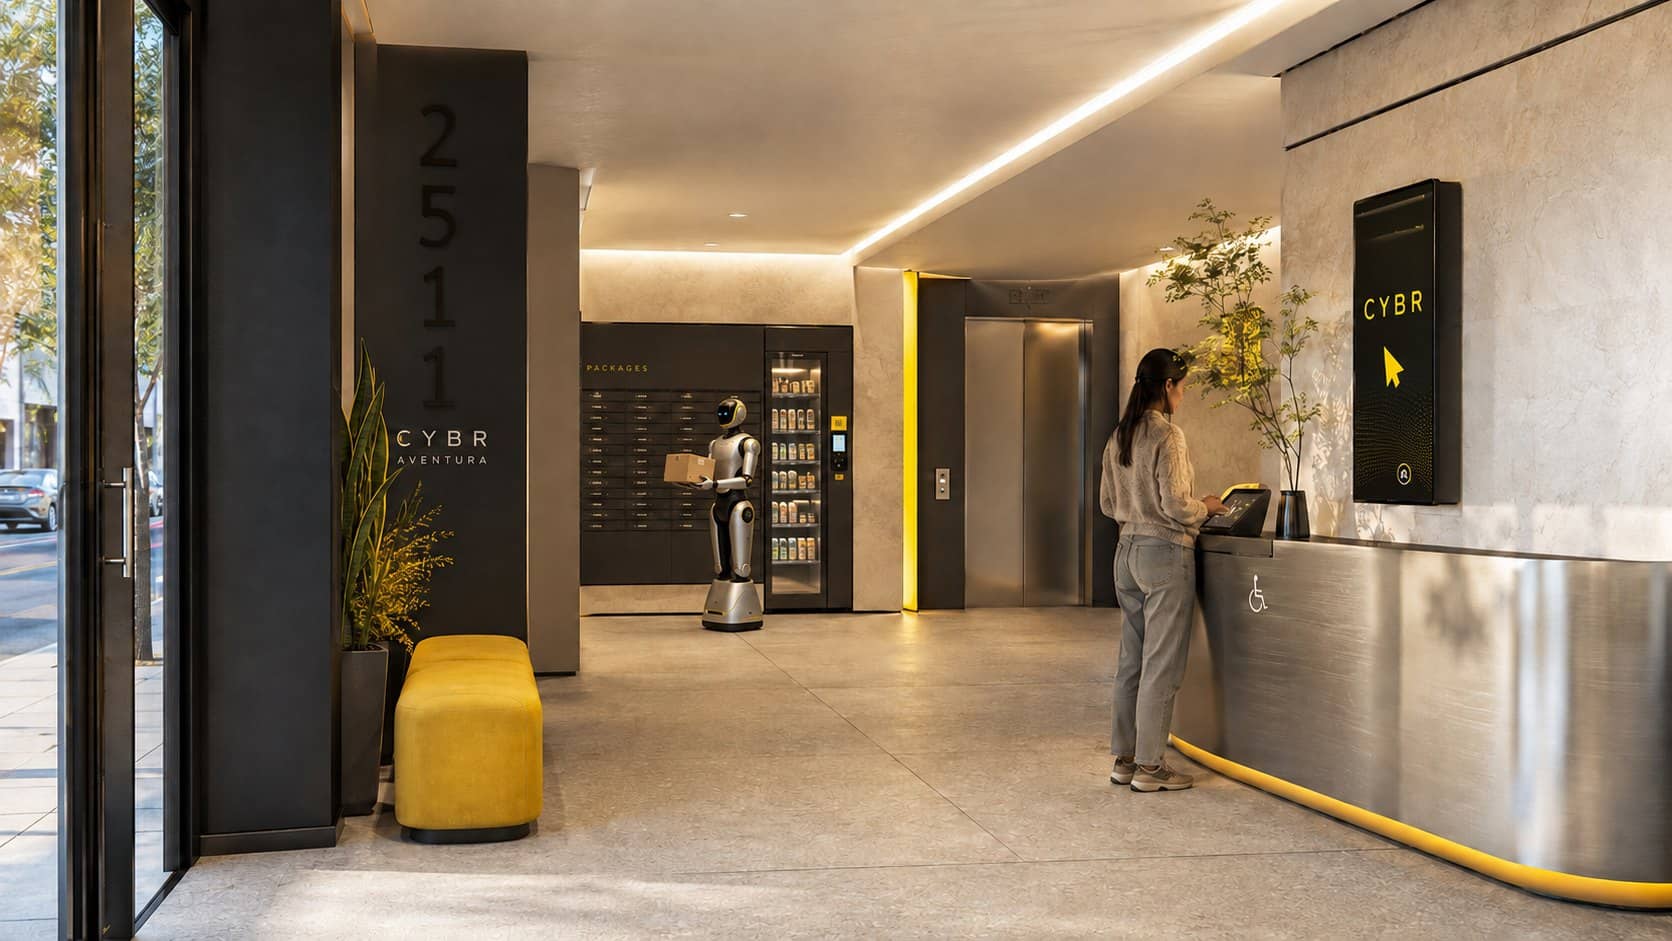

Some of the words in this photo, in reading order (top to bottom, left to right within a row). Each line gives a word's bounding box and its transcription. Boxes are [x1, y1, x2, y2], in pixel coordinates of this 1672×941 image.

[419, 103, 458, 411] 2511
[1363, 289, 1424, 321] CYBR
[586, 364, 649, 373] PACKAGES
[396, 430, 488, 447] CYBR
[396, 455, 488, 465] AVENTURA
